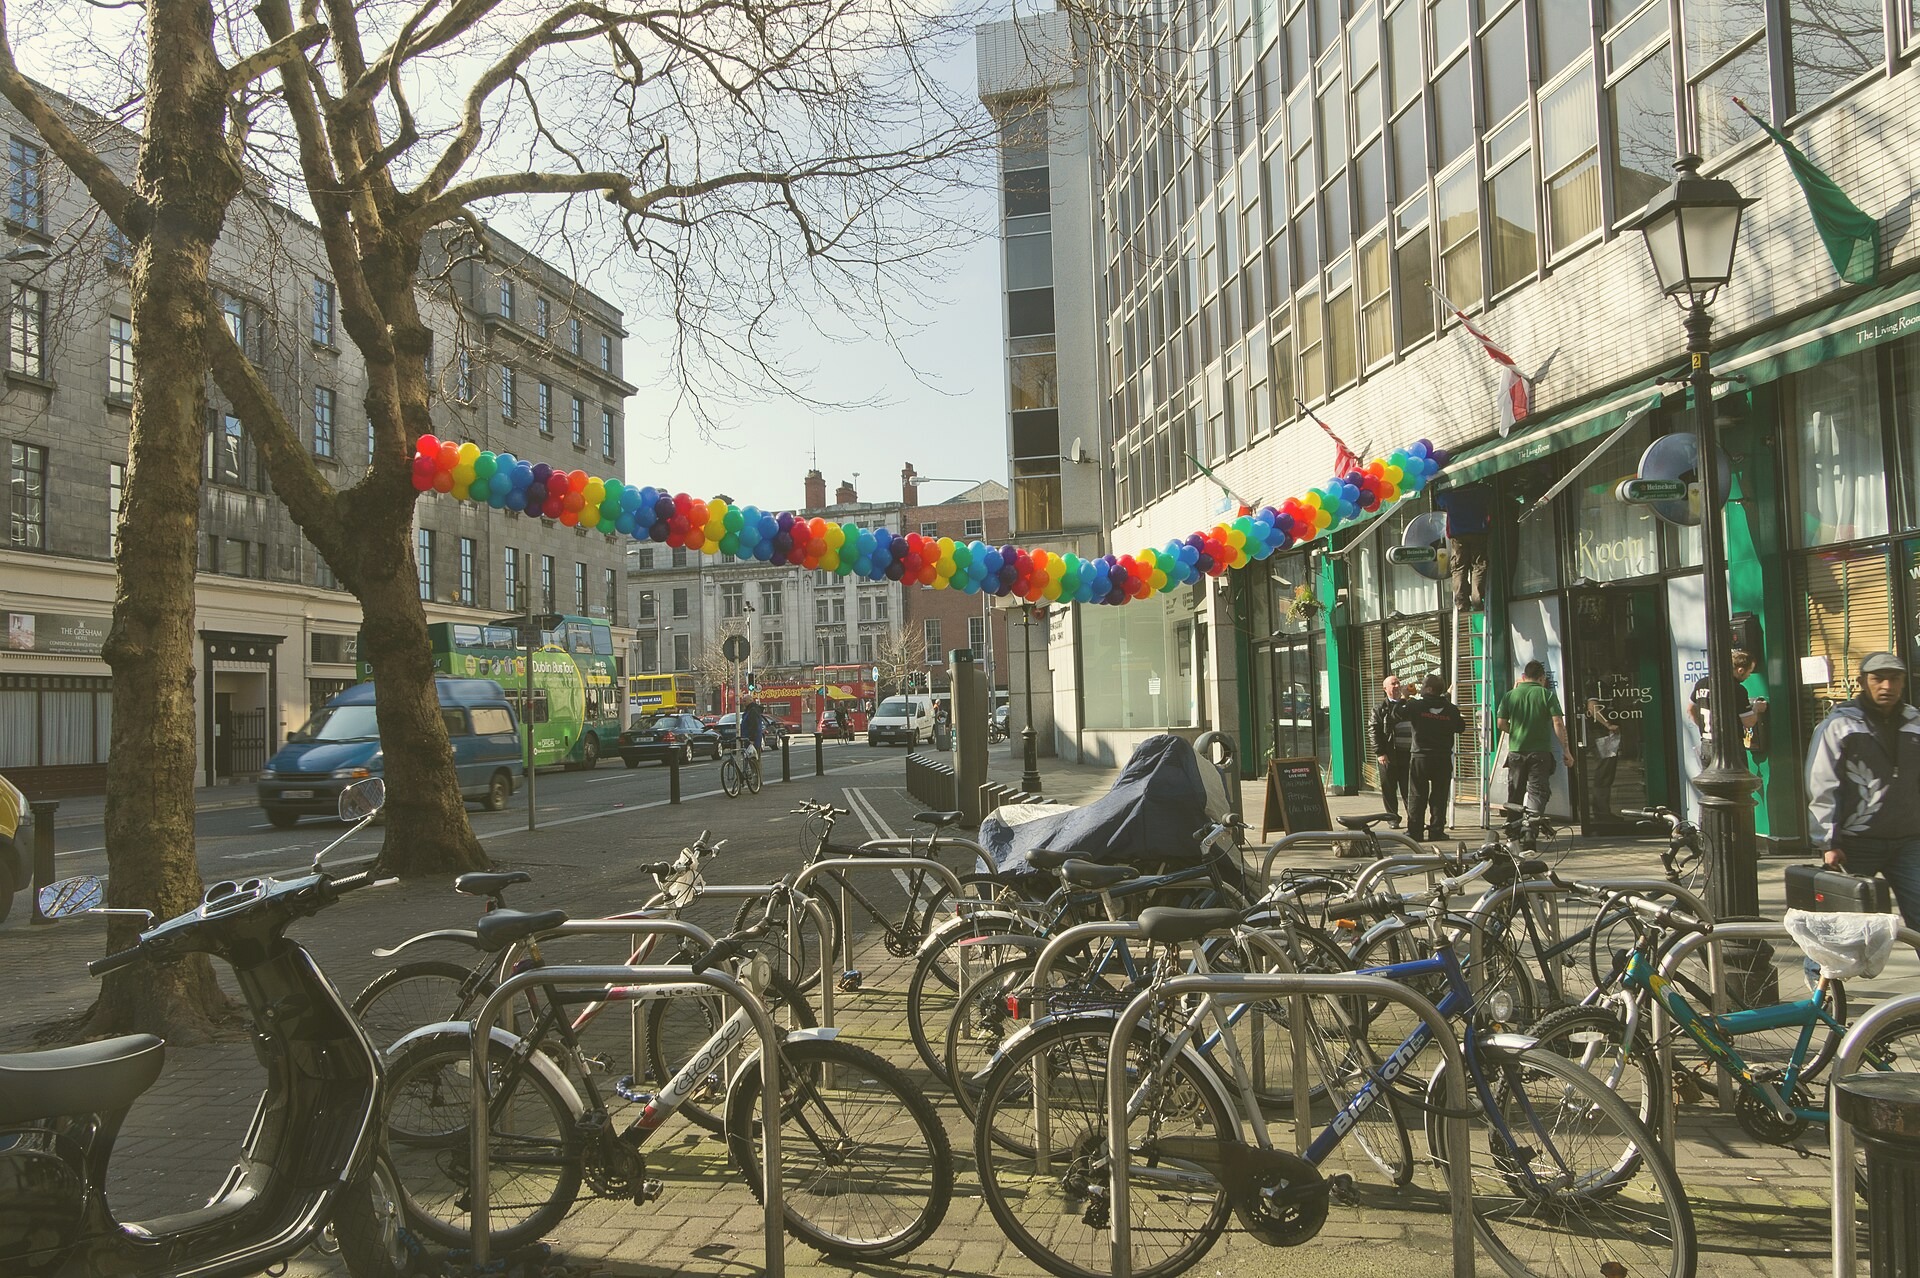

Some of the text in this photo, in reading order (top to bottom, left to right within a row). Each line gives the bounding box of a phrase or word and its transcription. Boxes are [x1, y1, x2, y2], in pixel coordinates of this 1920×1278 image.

[1856, 330, 1874, 344] The
[1874, 323, 1899, 339] Living
[1694, 356, 1699, 366] 2
[1646, 483, 1677, 491] Heineken
[1579, 528, 1644, 574] Room
[73, 628, 103, 637] GRESHAM
[532, 660, 552, 673] Dublin
[552, 661, 563, 674] Bus
[562, 661, 575, 674] Tour
[1686, 661, 1709, 672] COL
[1611, 673, 1629, 682] The
[1597, 681, 1653, 704] Living
[1422, 712, 1450, 720] HONDA
[1593, 704, 1643, 723] Room
